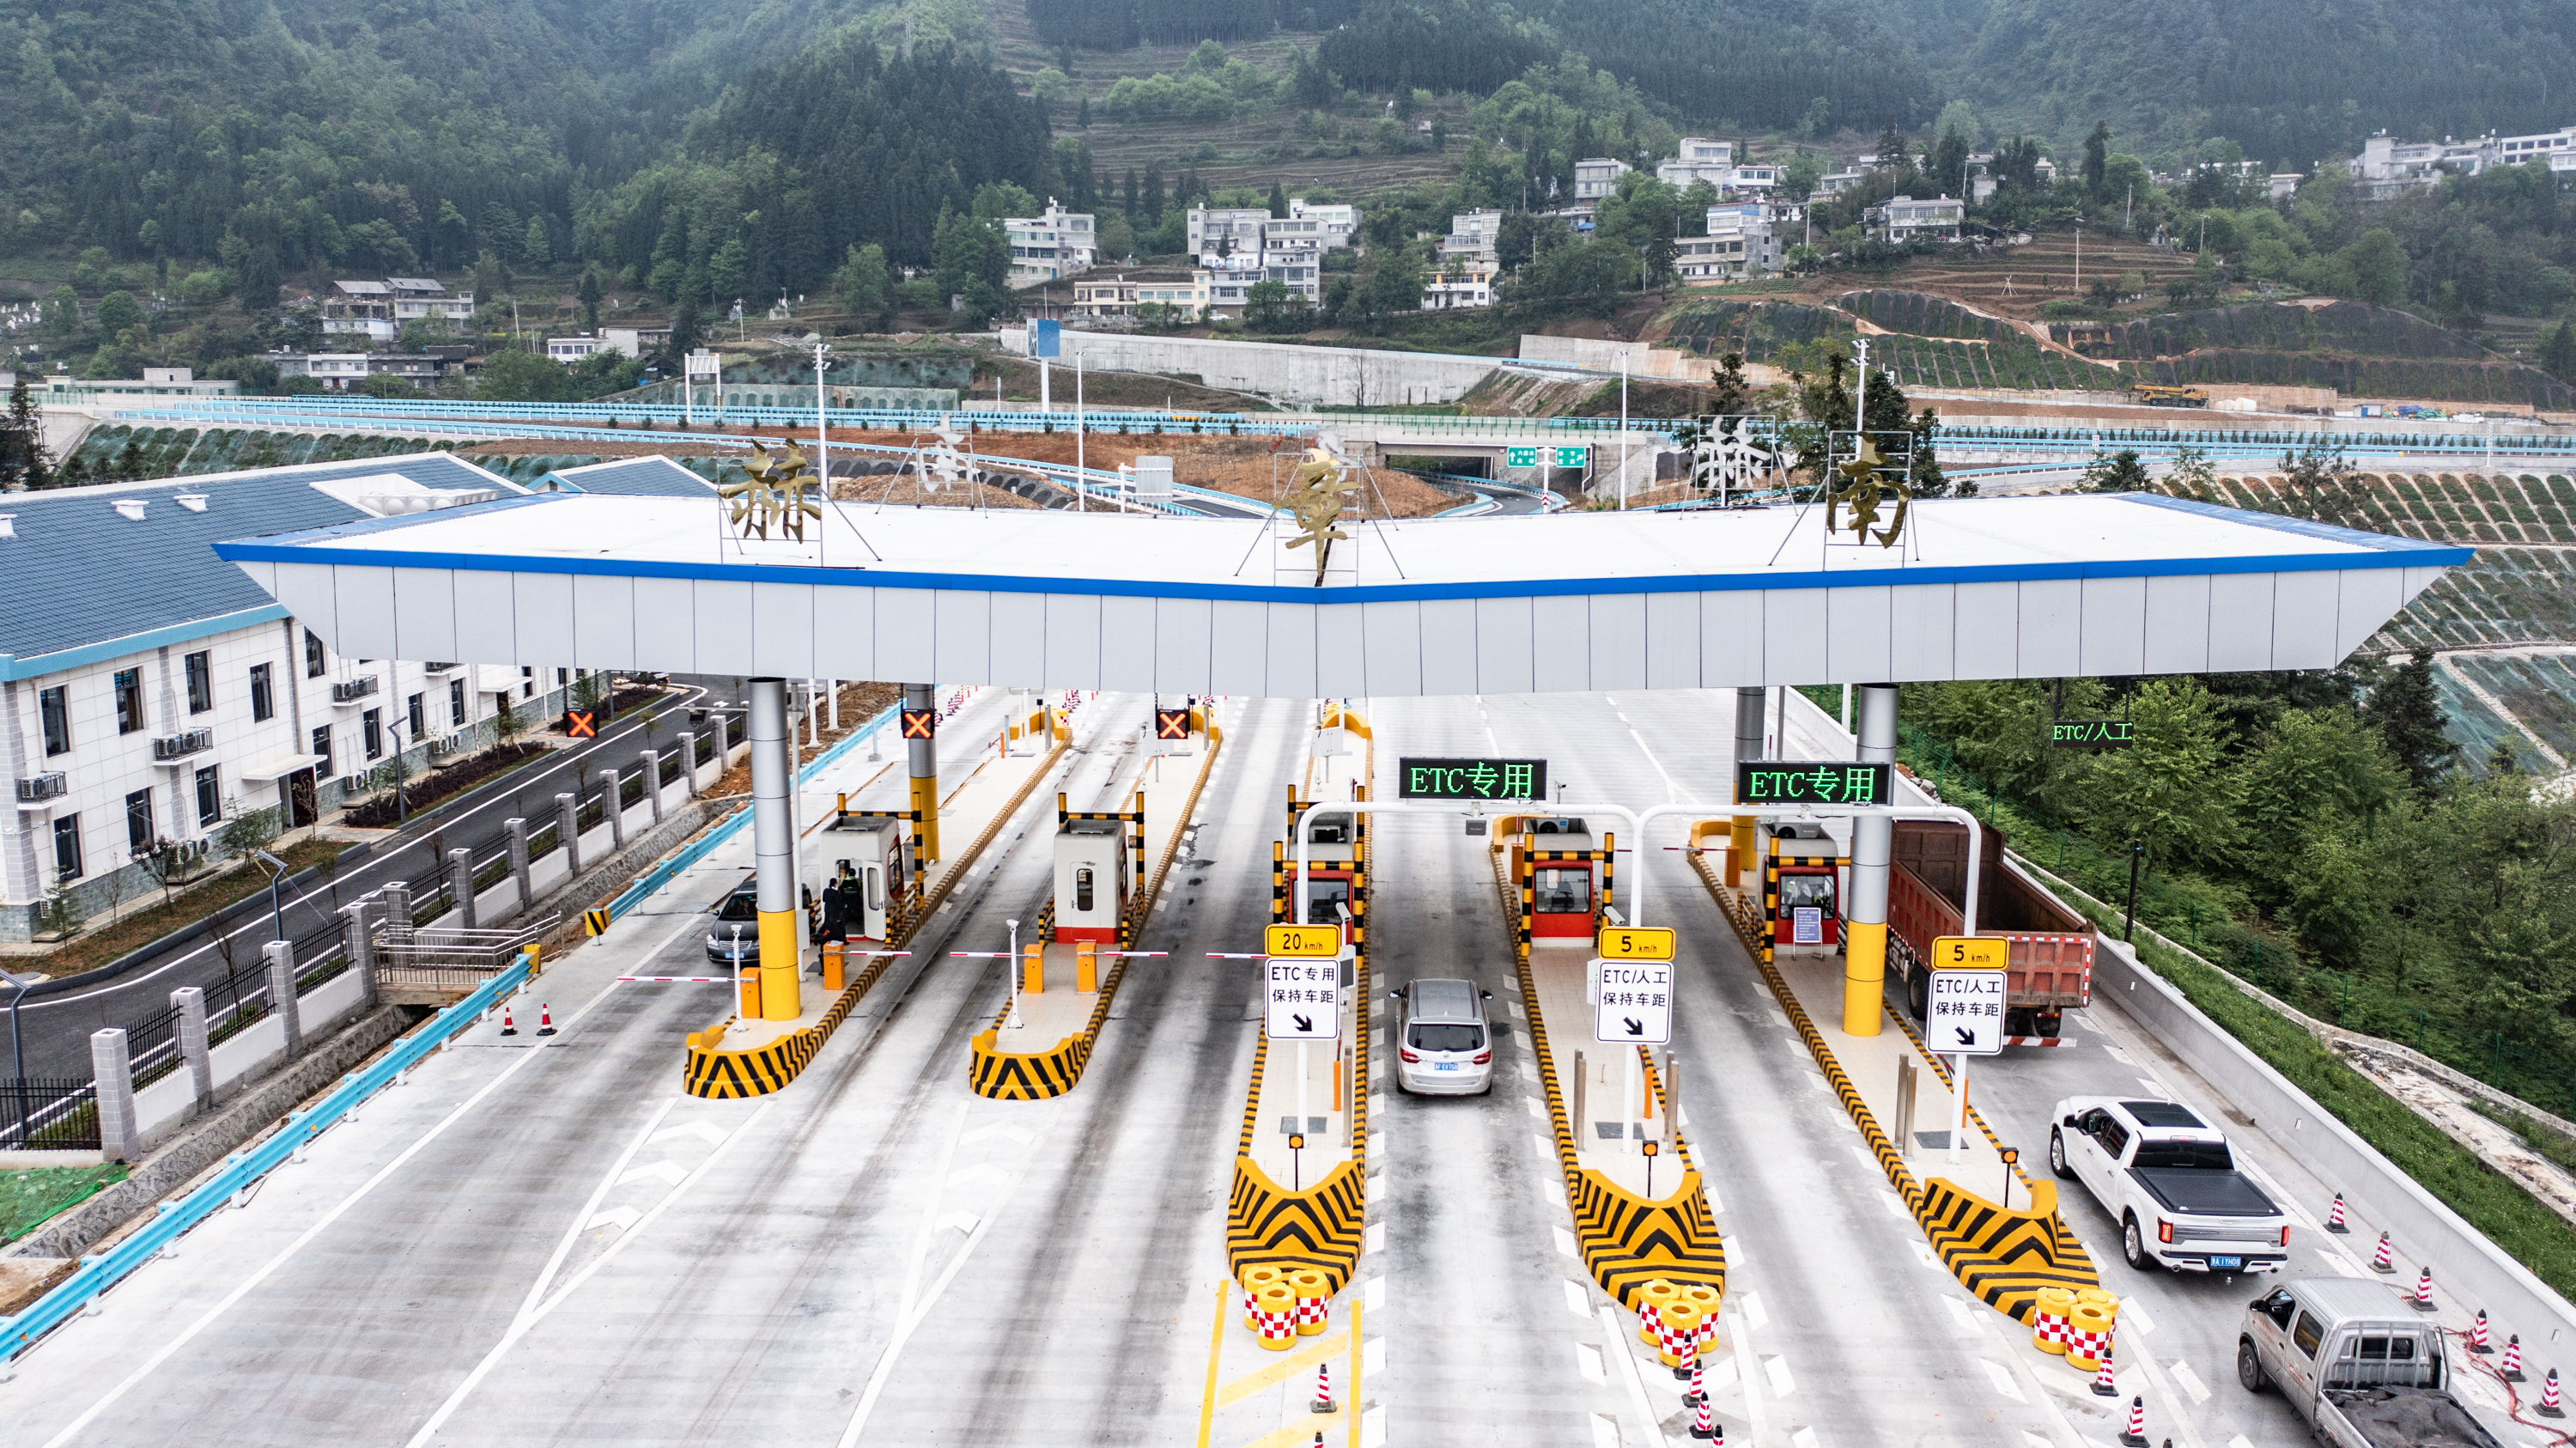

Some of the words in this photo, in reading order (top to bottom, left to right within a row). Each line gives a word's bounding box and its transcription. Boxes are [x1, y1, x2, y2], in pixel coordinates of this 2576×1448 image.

[2052, 722, 2133, 741] ETC/人工
[1410, 761, 1534, 798] ETC专用
[1749, 765, 1876, 801] ETC专用
[1282, 933, 1301, 950] 20
[1304, 941, 1323, 951] km/h
[1621, 935, 1632, 952] 5
[1638, 944, 1657, 953] km/h
[1953, 945, 1965, 962] 5
[1971, 953, 1990, 963] km/h
[1603, 970, 1668, 984] ETC/人工
[1935, 979, 2001, 994] ETC/人工
[1272, 989, 1334, 1003] 保持车距
[1603, 992, 1666, 1007] 保持车距
[1935, 1001, 1999, 1017] 保持车距
